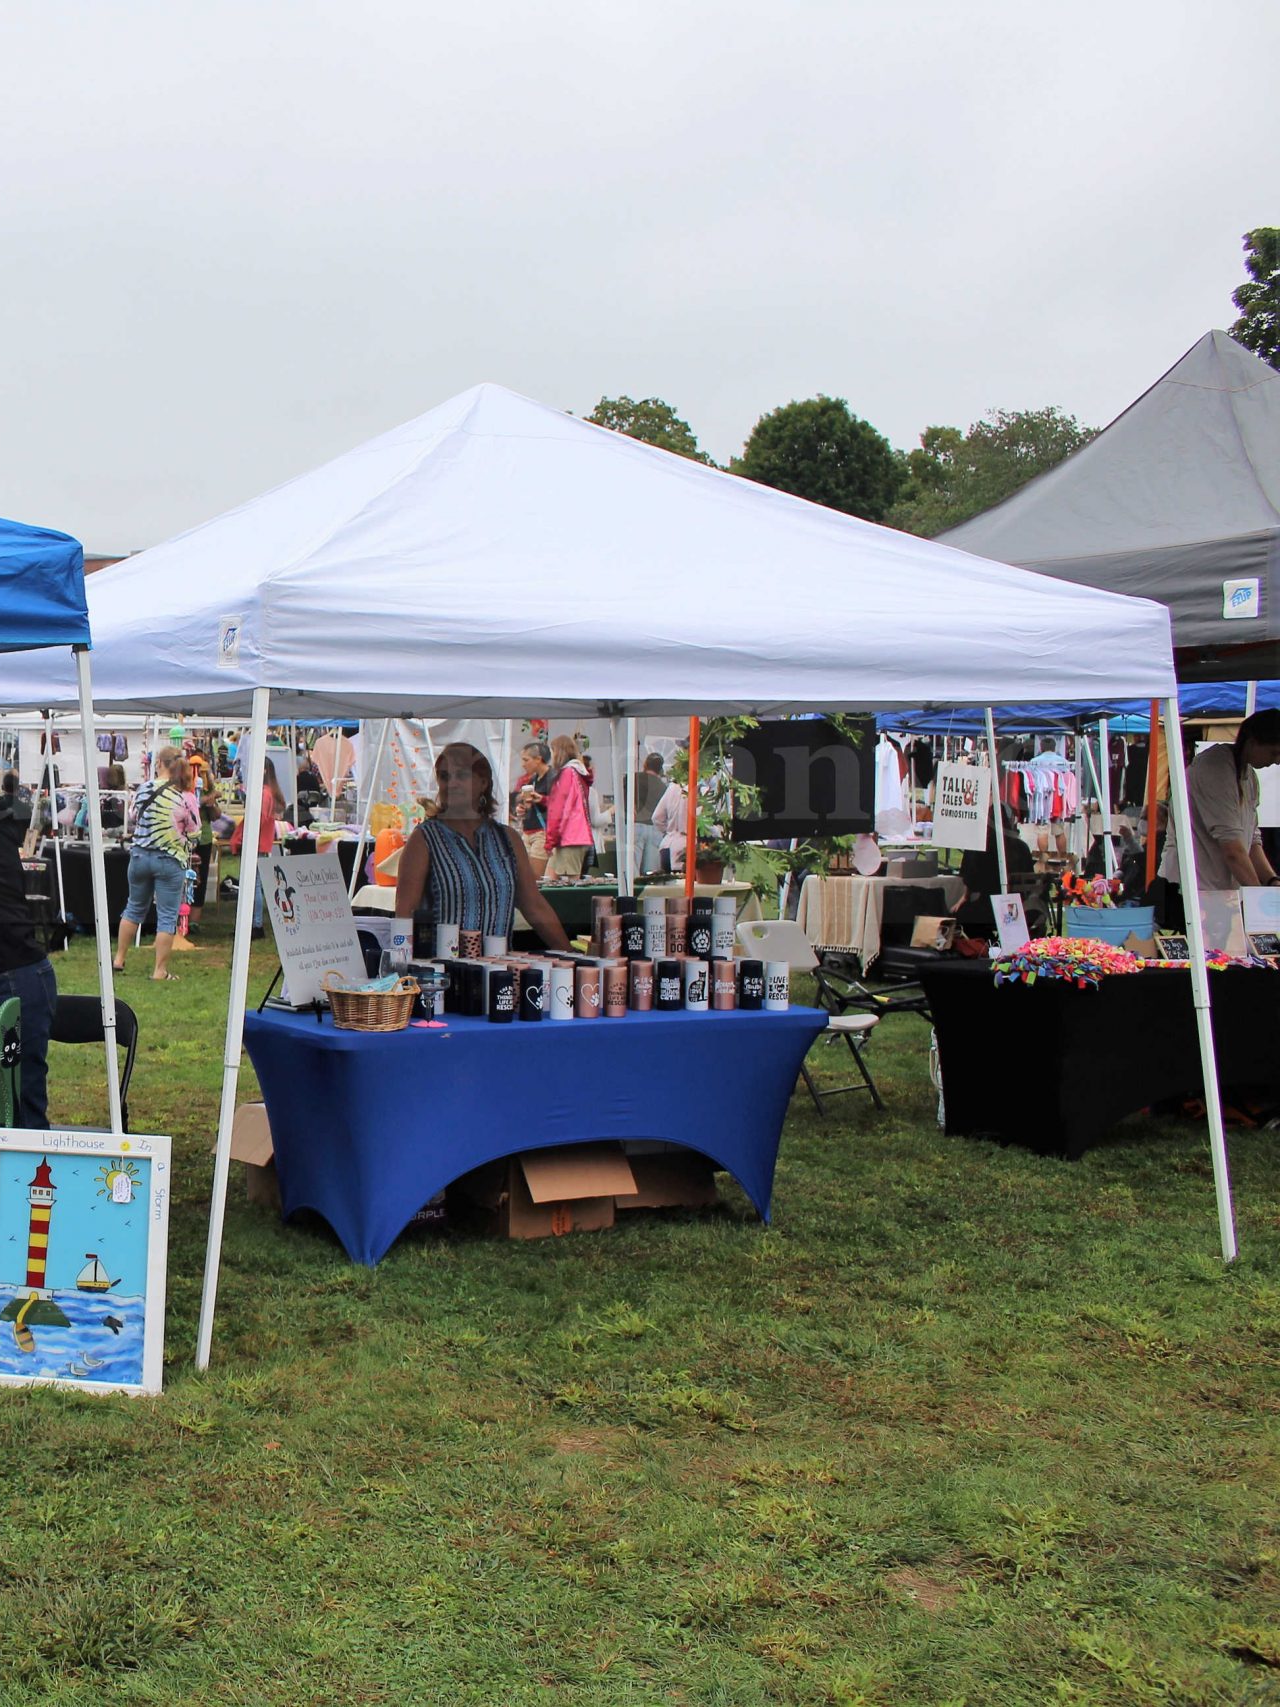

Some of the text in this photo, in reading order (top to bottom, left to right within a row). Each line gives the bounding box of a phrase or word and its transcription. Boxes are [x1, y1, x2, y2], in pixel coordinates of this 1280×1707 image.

[943, 776, 965, 793] TALL
[942, 794, 962, 806] TALES
[941, 808, 977, 820] CURIOSITIES
[42, 1134, 105, 1151] Lighthouse
[137, 1139, 153, 1152] In
[154, 1188, 166, 1221] Storm
